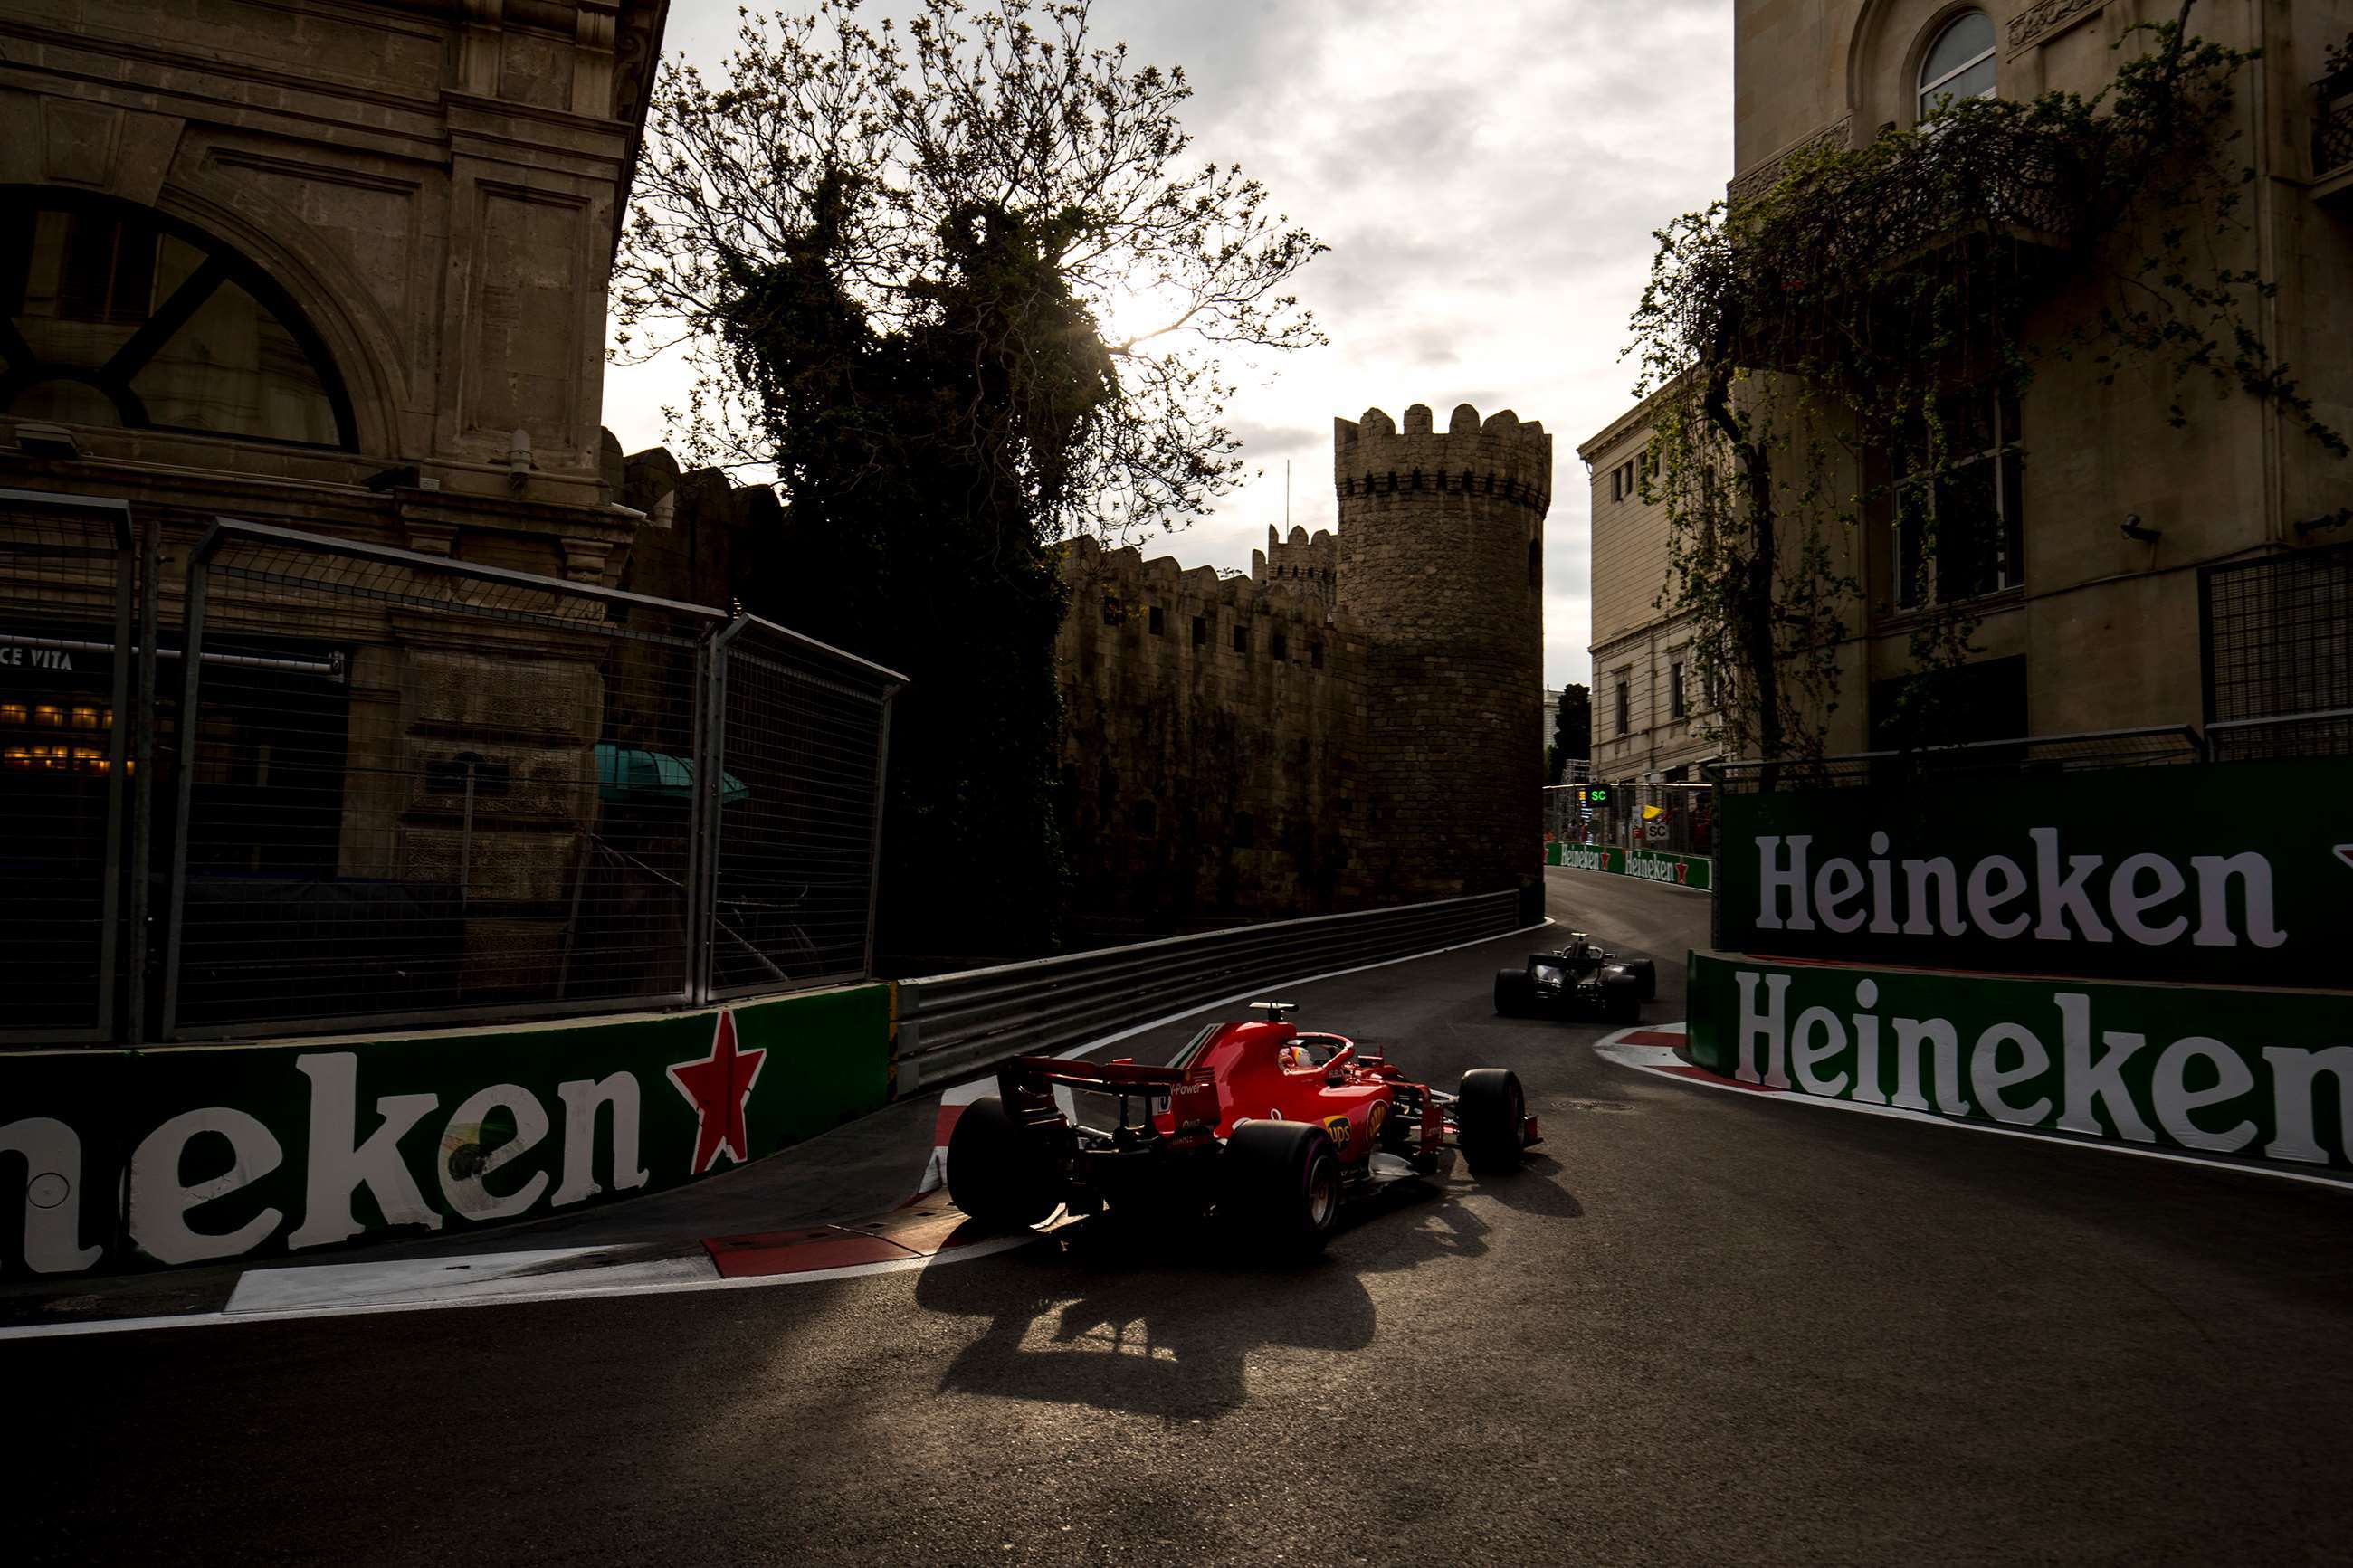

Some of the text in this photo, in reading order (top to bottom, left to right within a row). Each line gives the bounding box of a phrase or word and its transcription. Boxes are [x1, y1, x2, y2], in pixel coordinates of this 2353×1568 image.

[0, 647, 73, 670] CE VITA
[1591, 791, 1607, 801] SC
[1649, 825, 1666, 837] SC
[1561, 843, 1600, 870] Heineken
[1625, 850, 1674, 881] Heineken
[1754, 826, 2288, 949] Heineken
[1734, 970, 2353, 1164] Heineken
[1329, 1125, 1351, 1150] ups
